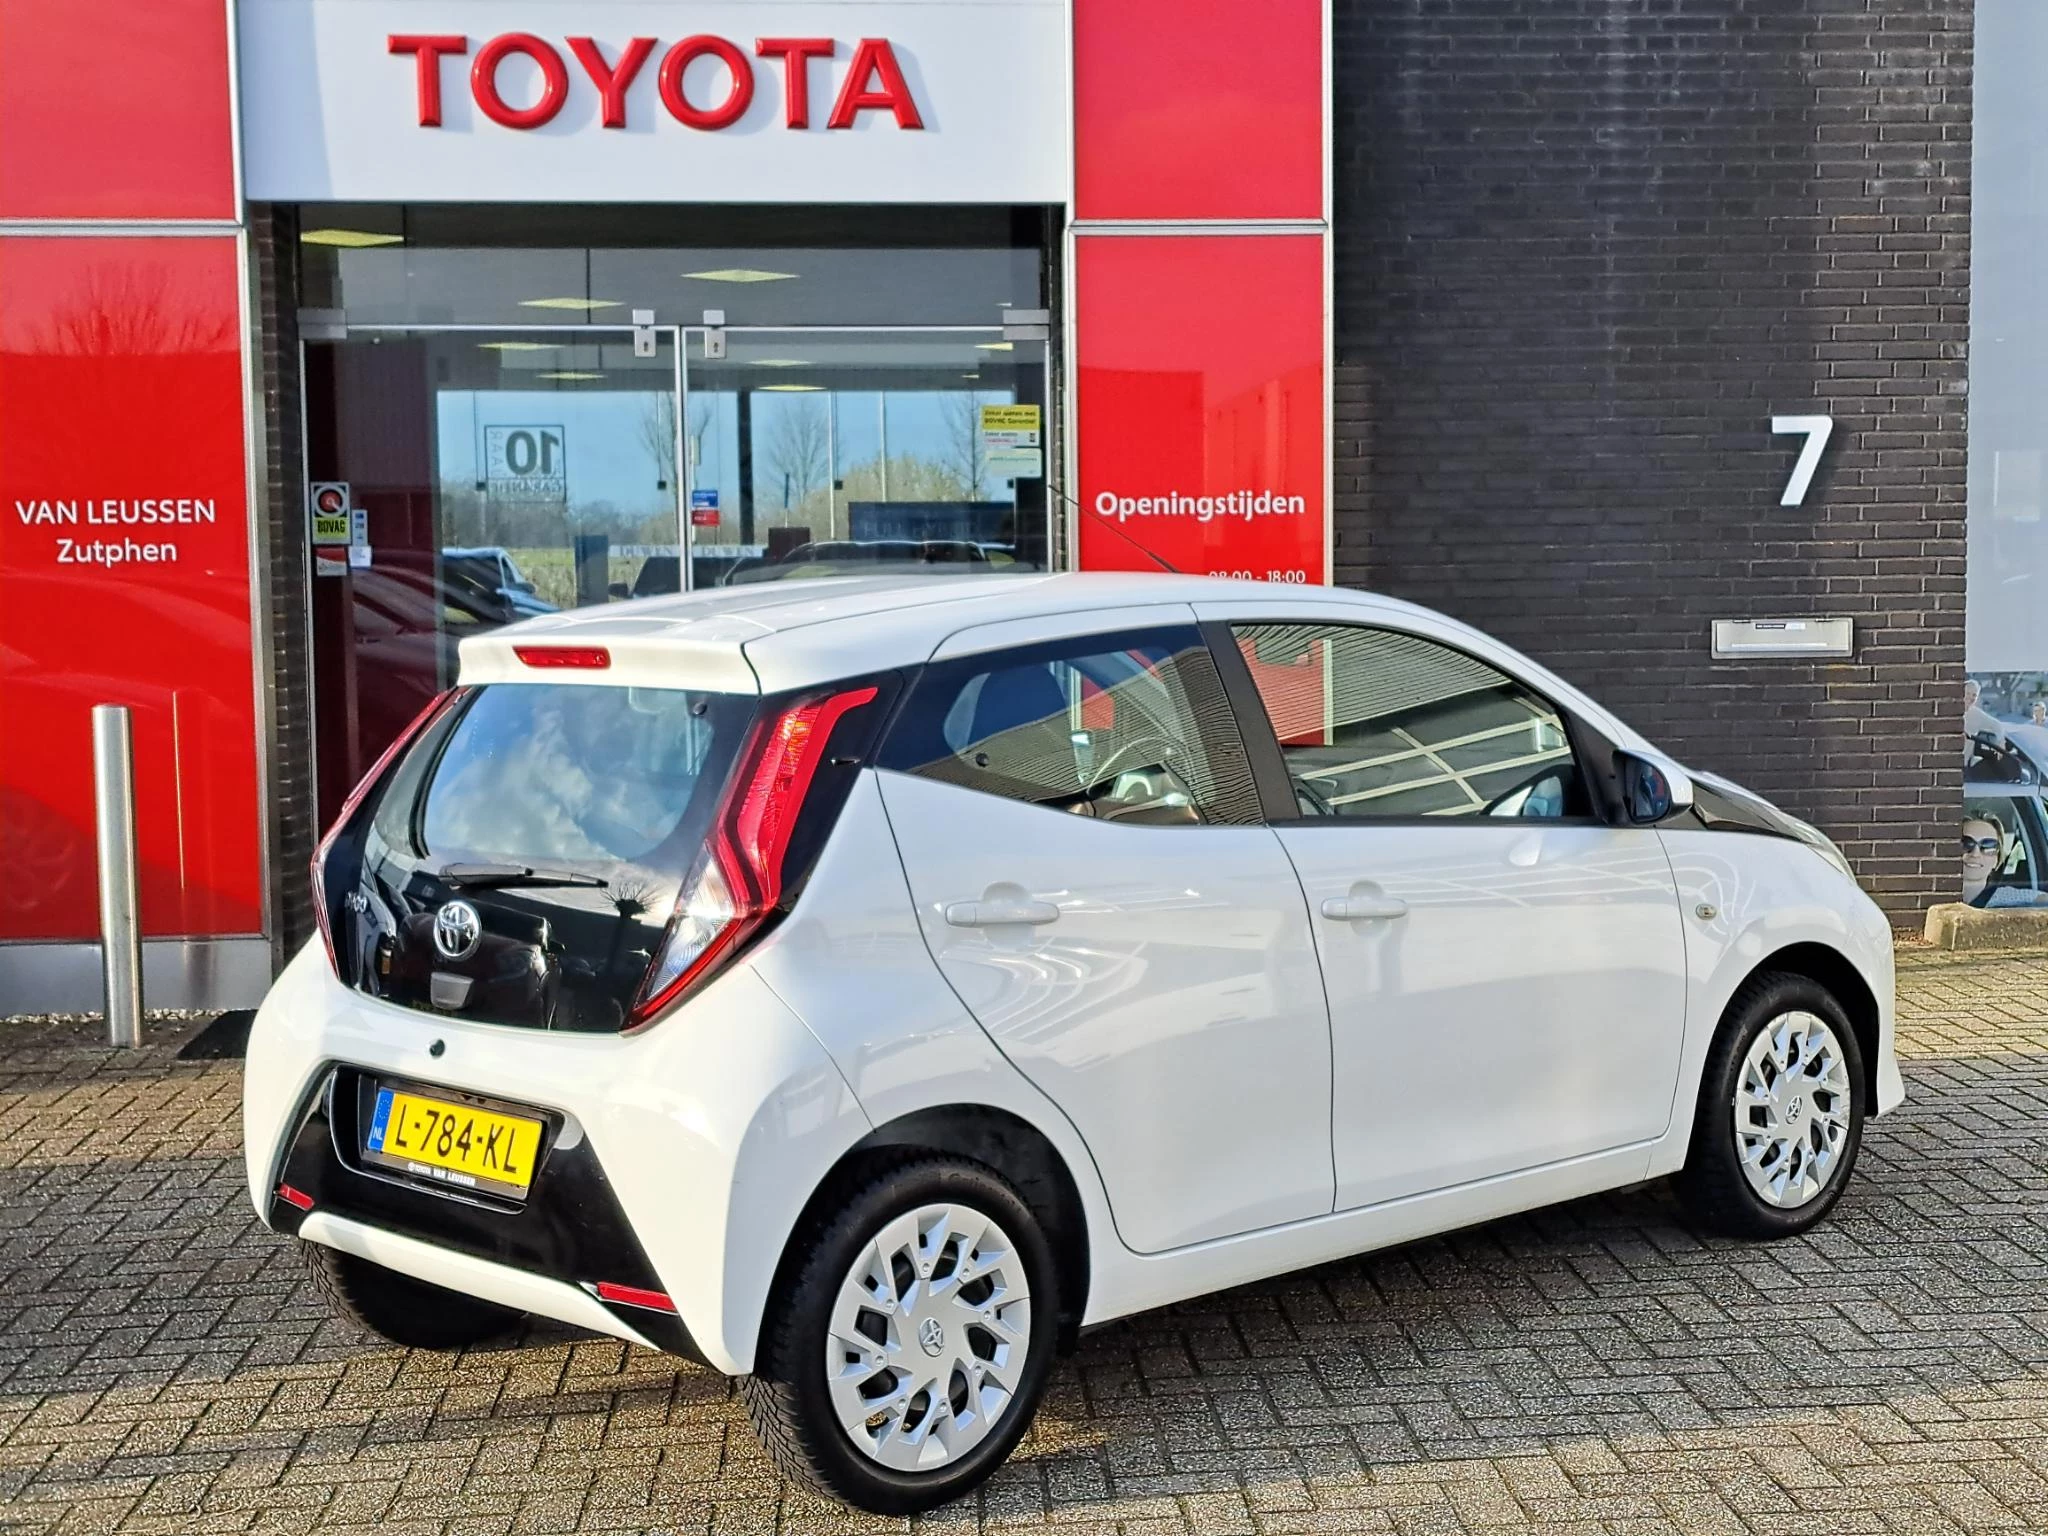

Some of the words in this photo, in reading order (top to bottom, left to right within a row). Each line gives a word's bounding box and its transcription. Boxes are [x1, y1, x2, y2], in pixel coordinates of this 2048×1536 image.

[387, 32, 925, 131] TOYOTA
[1771, 415, 1833, 507] 7
[15, 500, 78, 525] VAN
[87, 499, 216, 524] LEUSSEN
[1095, 490, 1306, 522] Openingstijden
[317, 520, 346, 533] BOVAG
[56, 537, 177, 567] Zutphen
[1266, 570, 1306, 584] 18:00
[372, 1126, 383, 1141] NL
[395, 1104, 518, 1174] L-784-KL
[433, 1167, 446, 1179] VAN
[447, 1171, 476, 1187] LEUSSEN
